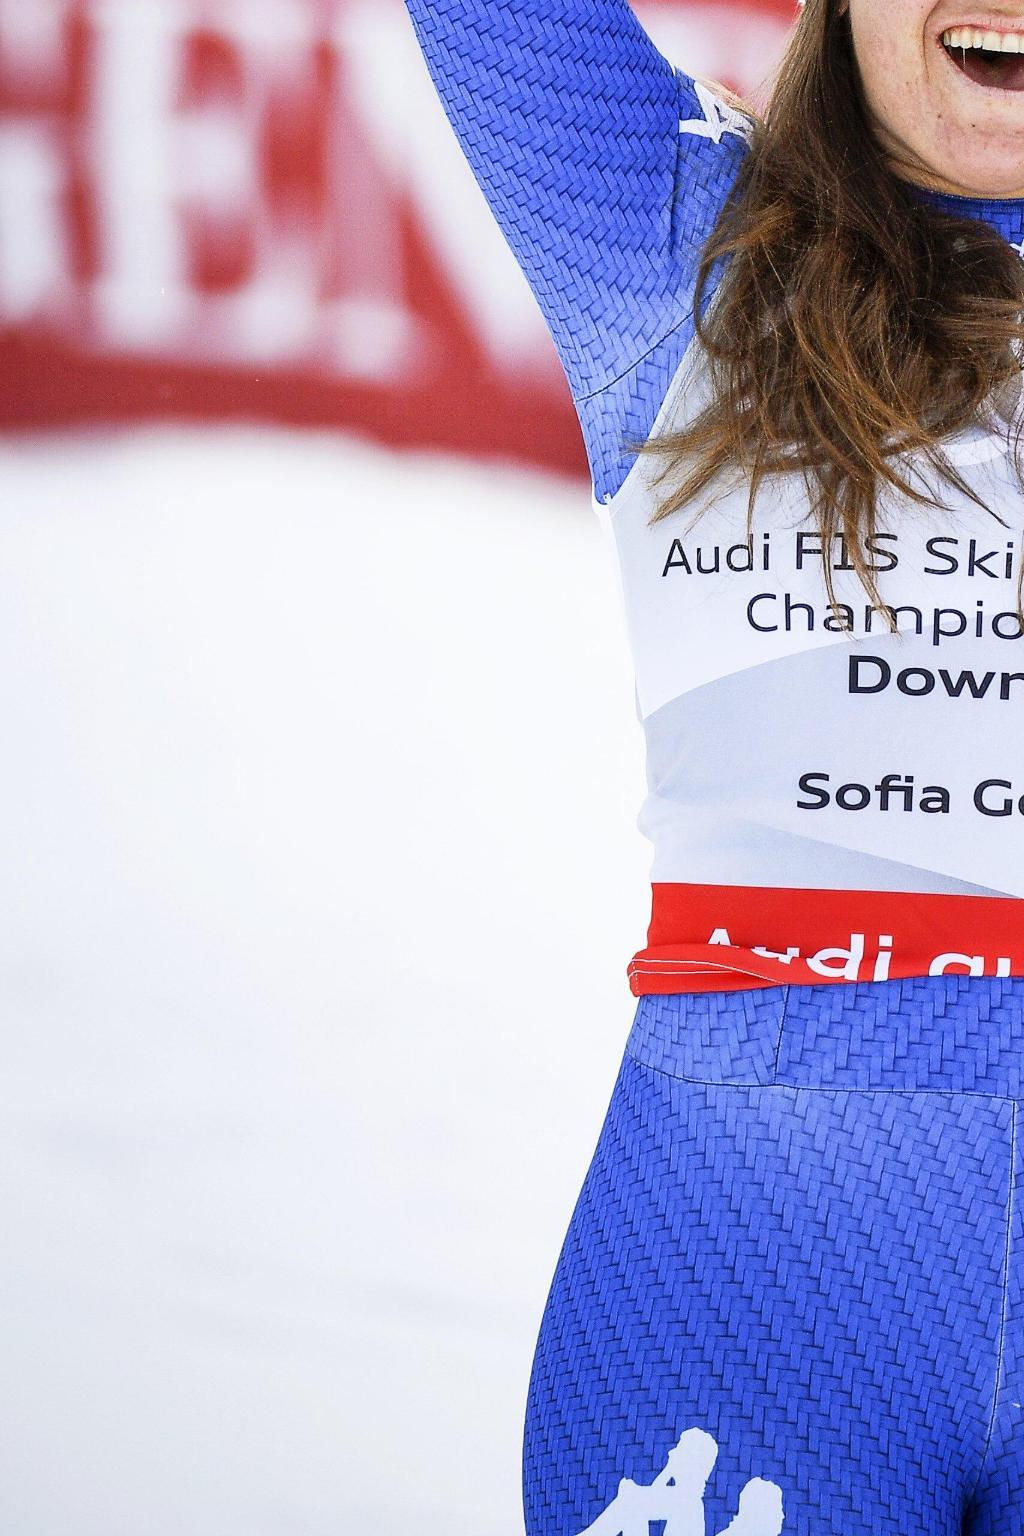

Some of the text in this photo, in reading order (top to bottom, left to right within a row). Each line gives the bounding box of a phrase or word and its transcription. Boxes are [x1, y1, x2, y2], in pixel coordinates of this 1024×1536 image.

[661, 532, 770, 577] Audi
[796, 531, 899, 572] FIS
[924, 536, 1014, 579] Ski
[796, 772, 951, 814] Sofia
